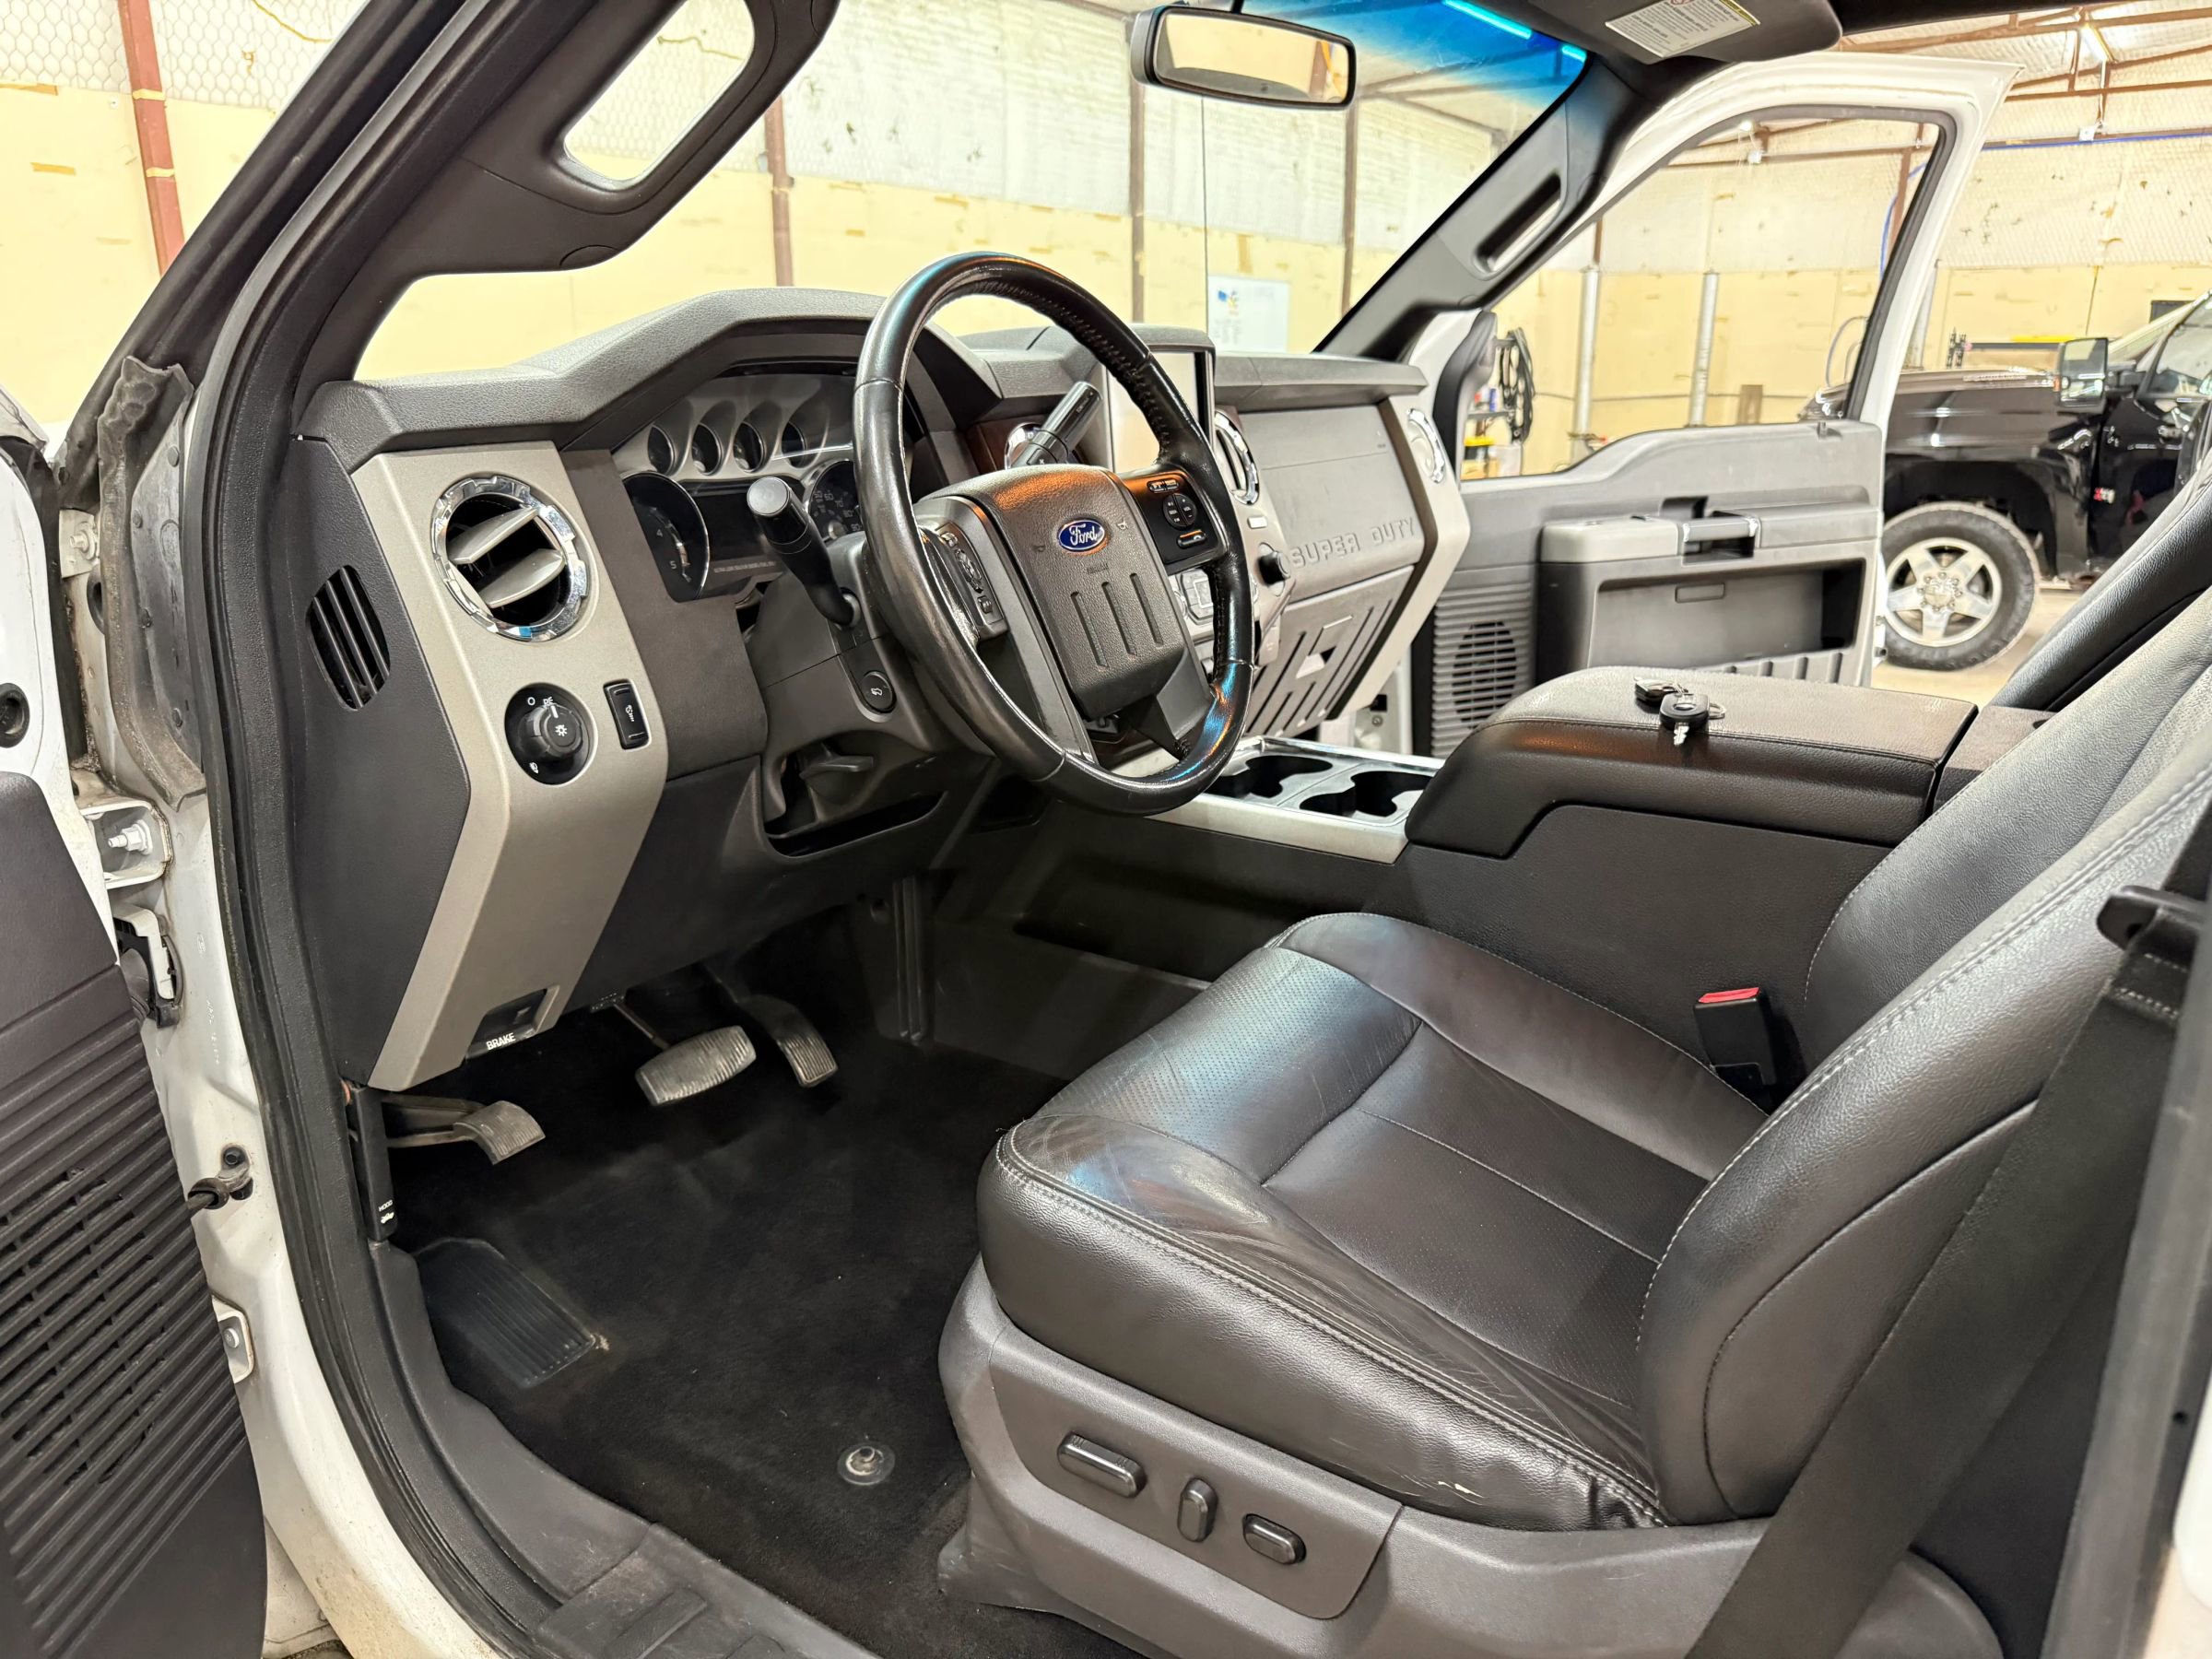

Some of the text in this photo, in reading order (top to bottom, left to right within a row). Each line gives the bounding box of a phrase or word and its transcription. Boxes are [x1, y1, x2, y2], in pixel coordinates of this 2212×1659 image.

[1069, 523, 1098, 547] Ford
[1291, 517, 1416, 569] SUPER DUTY
[670, 560, 677, 570] 5
[486, 1032, 516, 1051] BRAKE
[378, 1199, 394, 1212] HOOD
